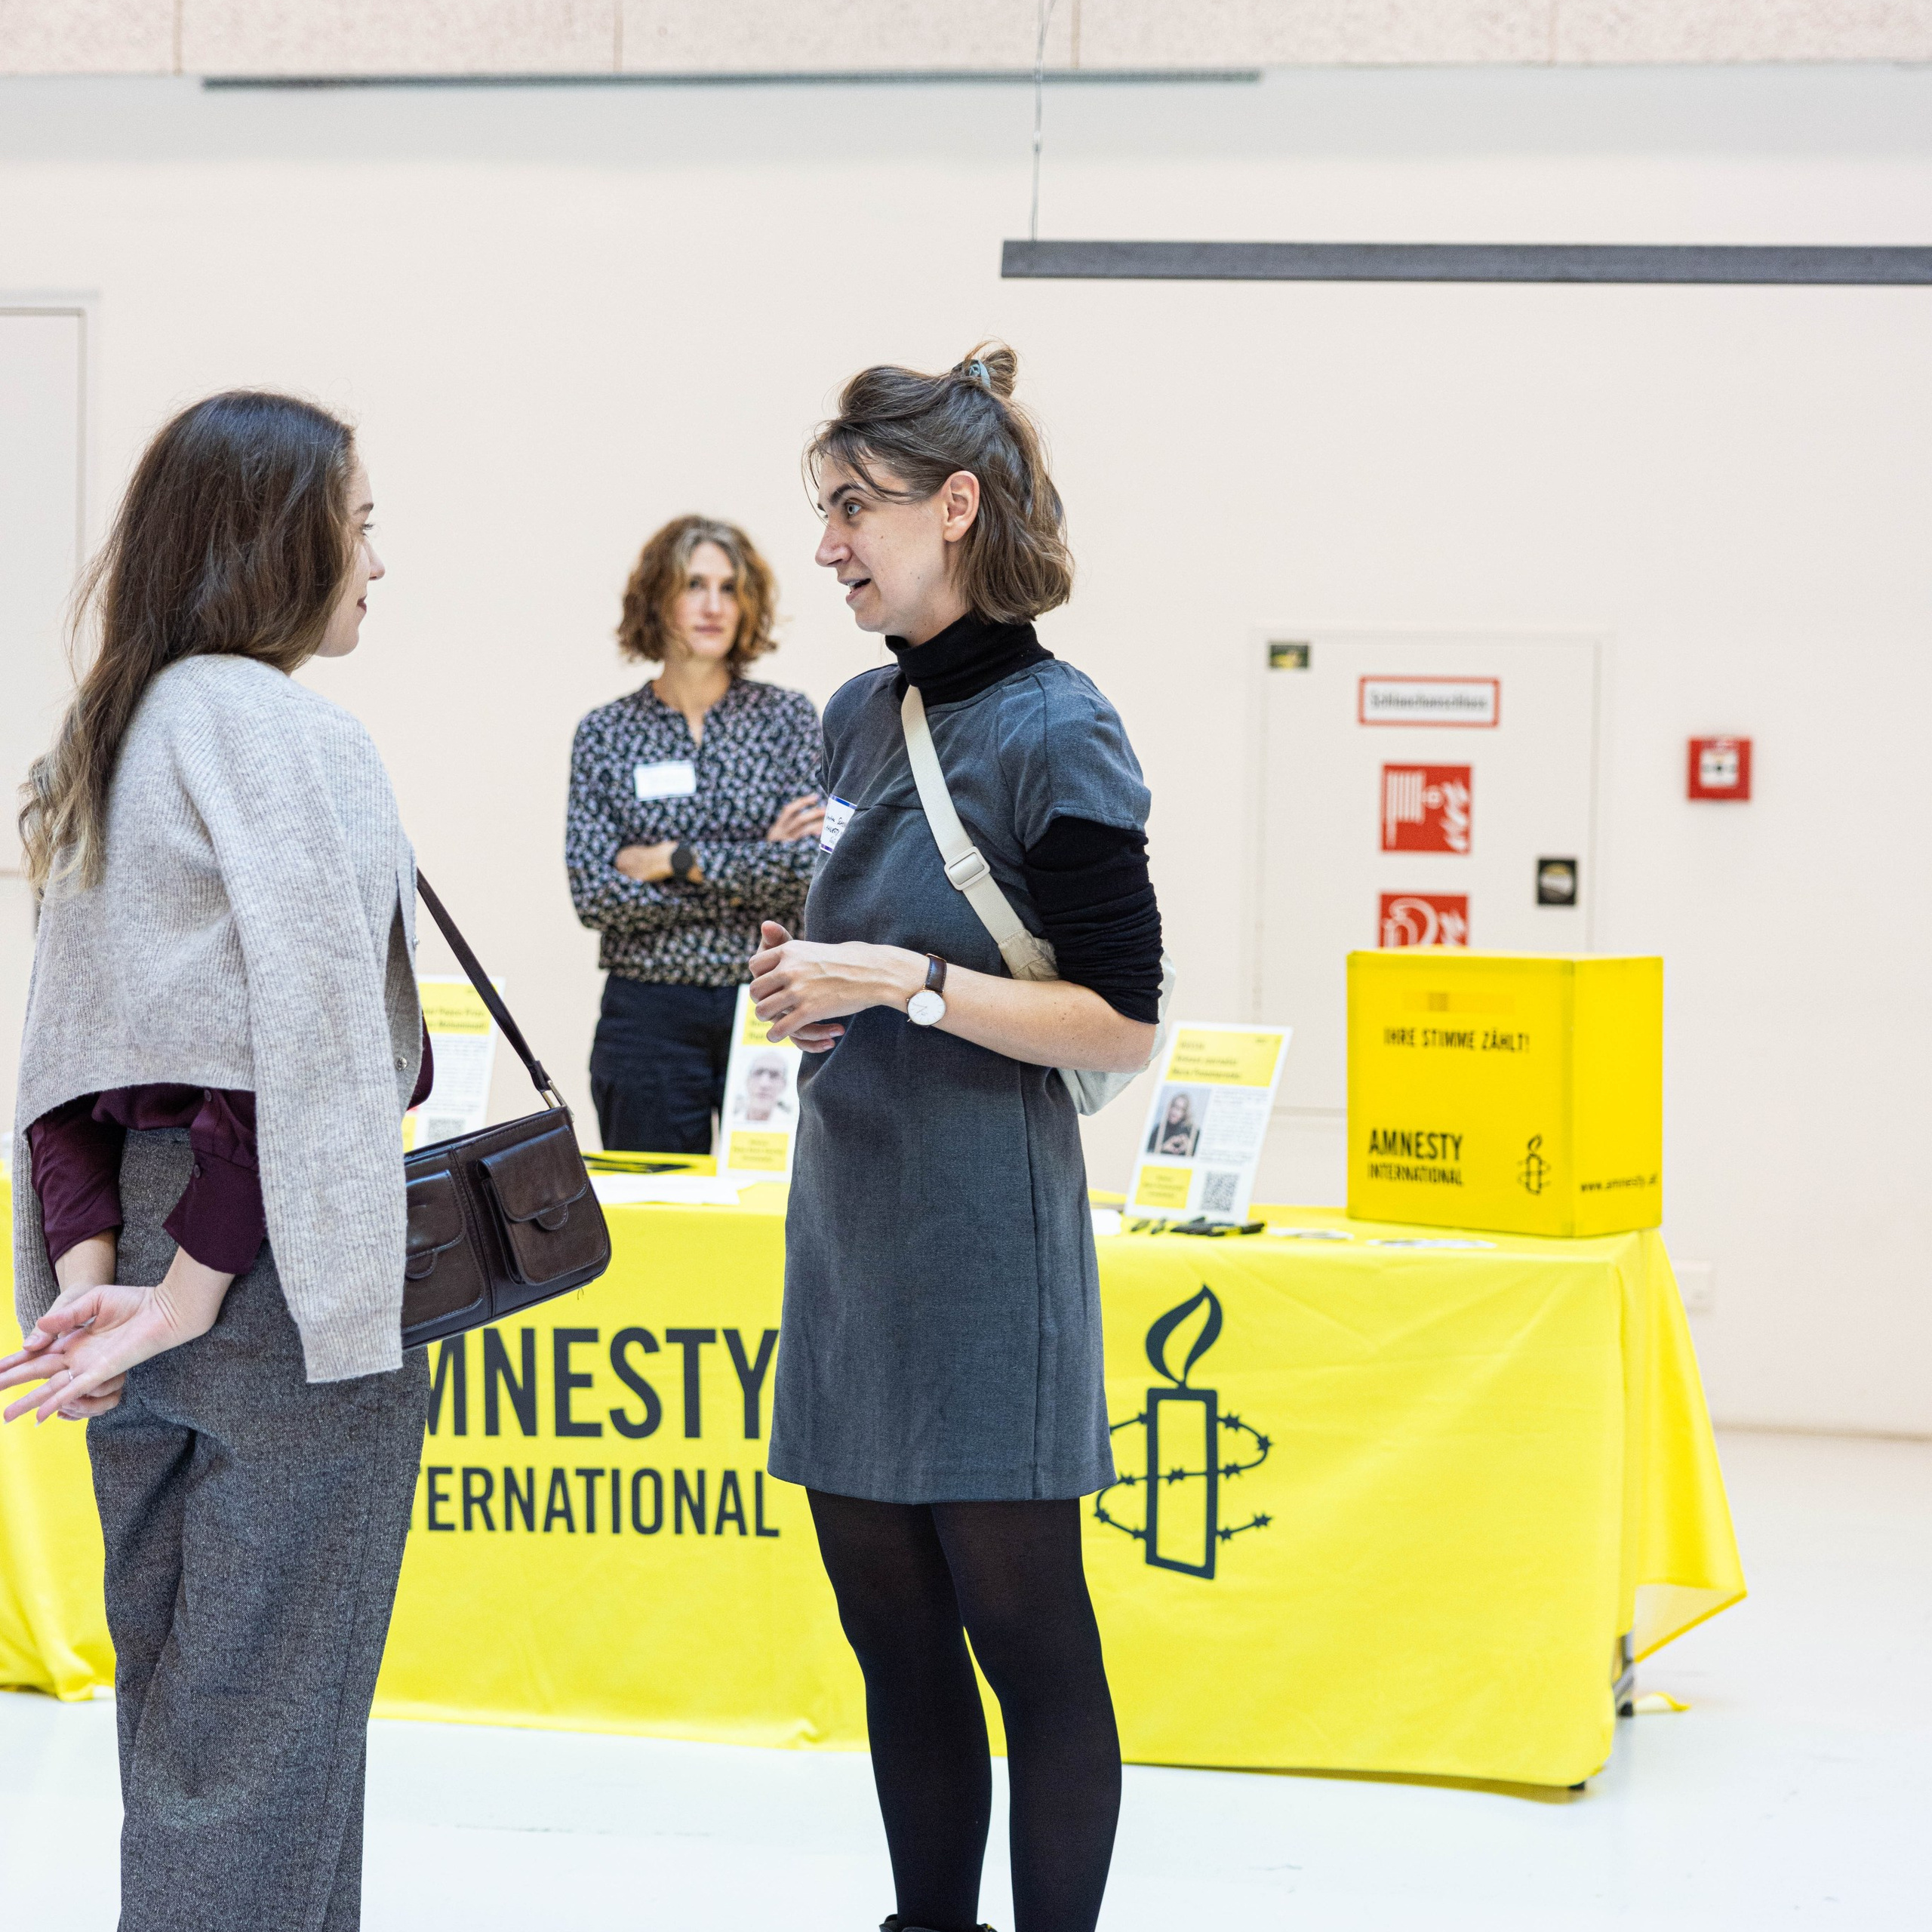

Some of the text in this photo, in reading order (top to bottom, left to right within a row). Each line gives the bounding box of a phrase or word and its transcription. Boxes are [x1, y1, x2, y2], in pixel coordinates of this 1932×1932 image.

[1383, 1027, 1415, 1048] IHRE
[1423, 1028, 1475, 1051] STIMME
[1368, 1128, 1463, 1161] AMNESTY
[1366, 1162, 1463, 1187] INTERNATIONAL
[426, 1326, 780, 1440] MNESTY
[411, 1465, 781, 1538] ERNATIONAL
